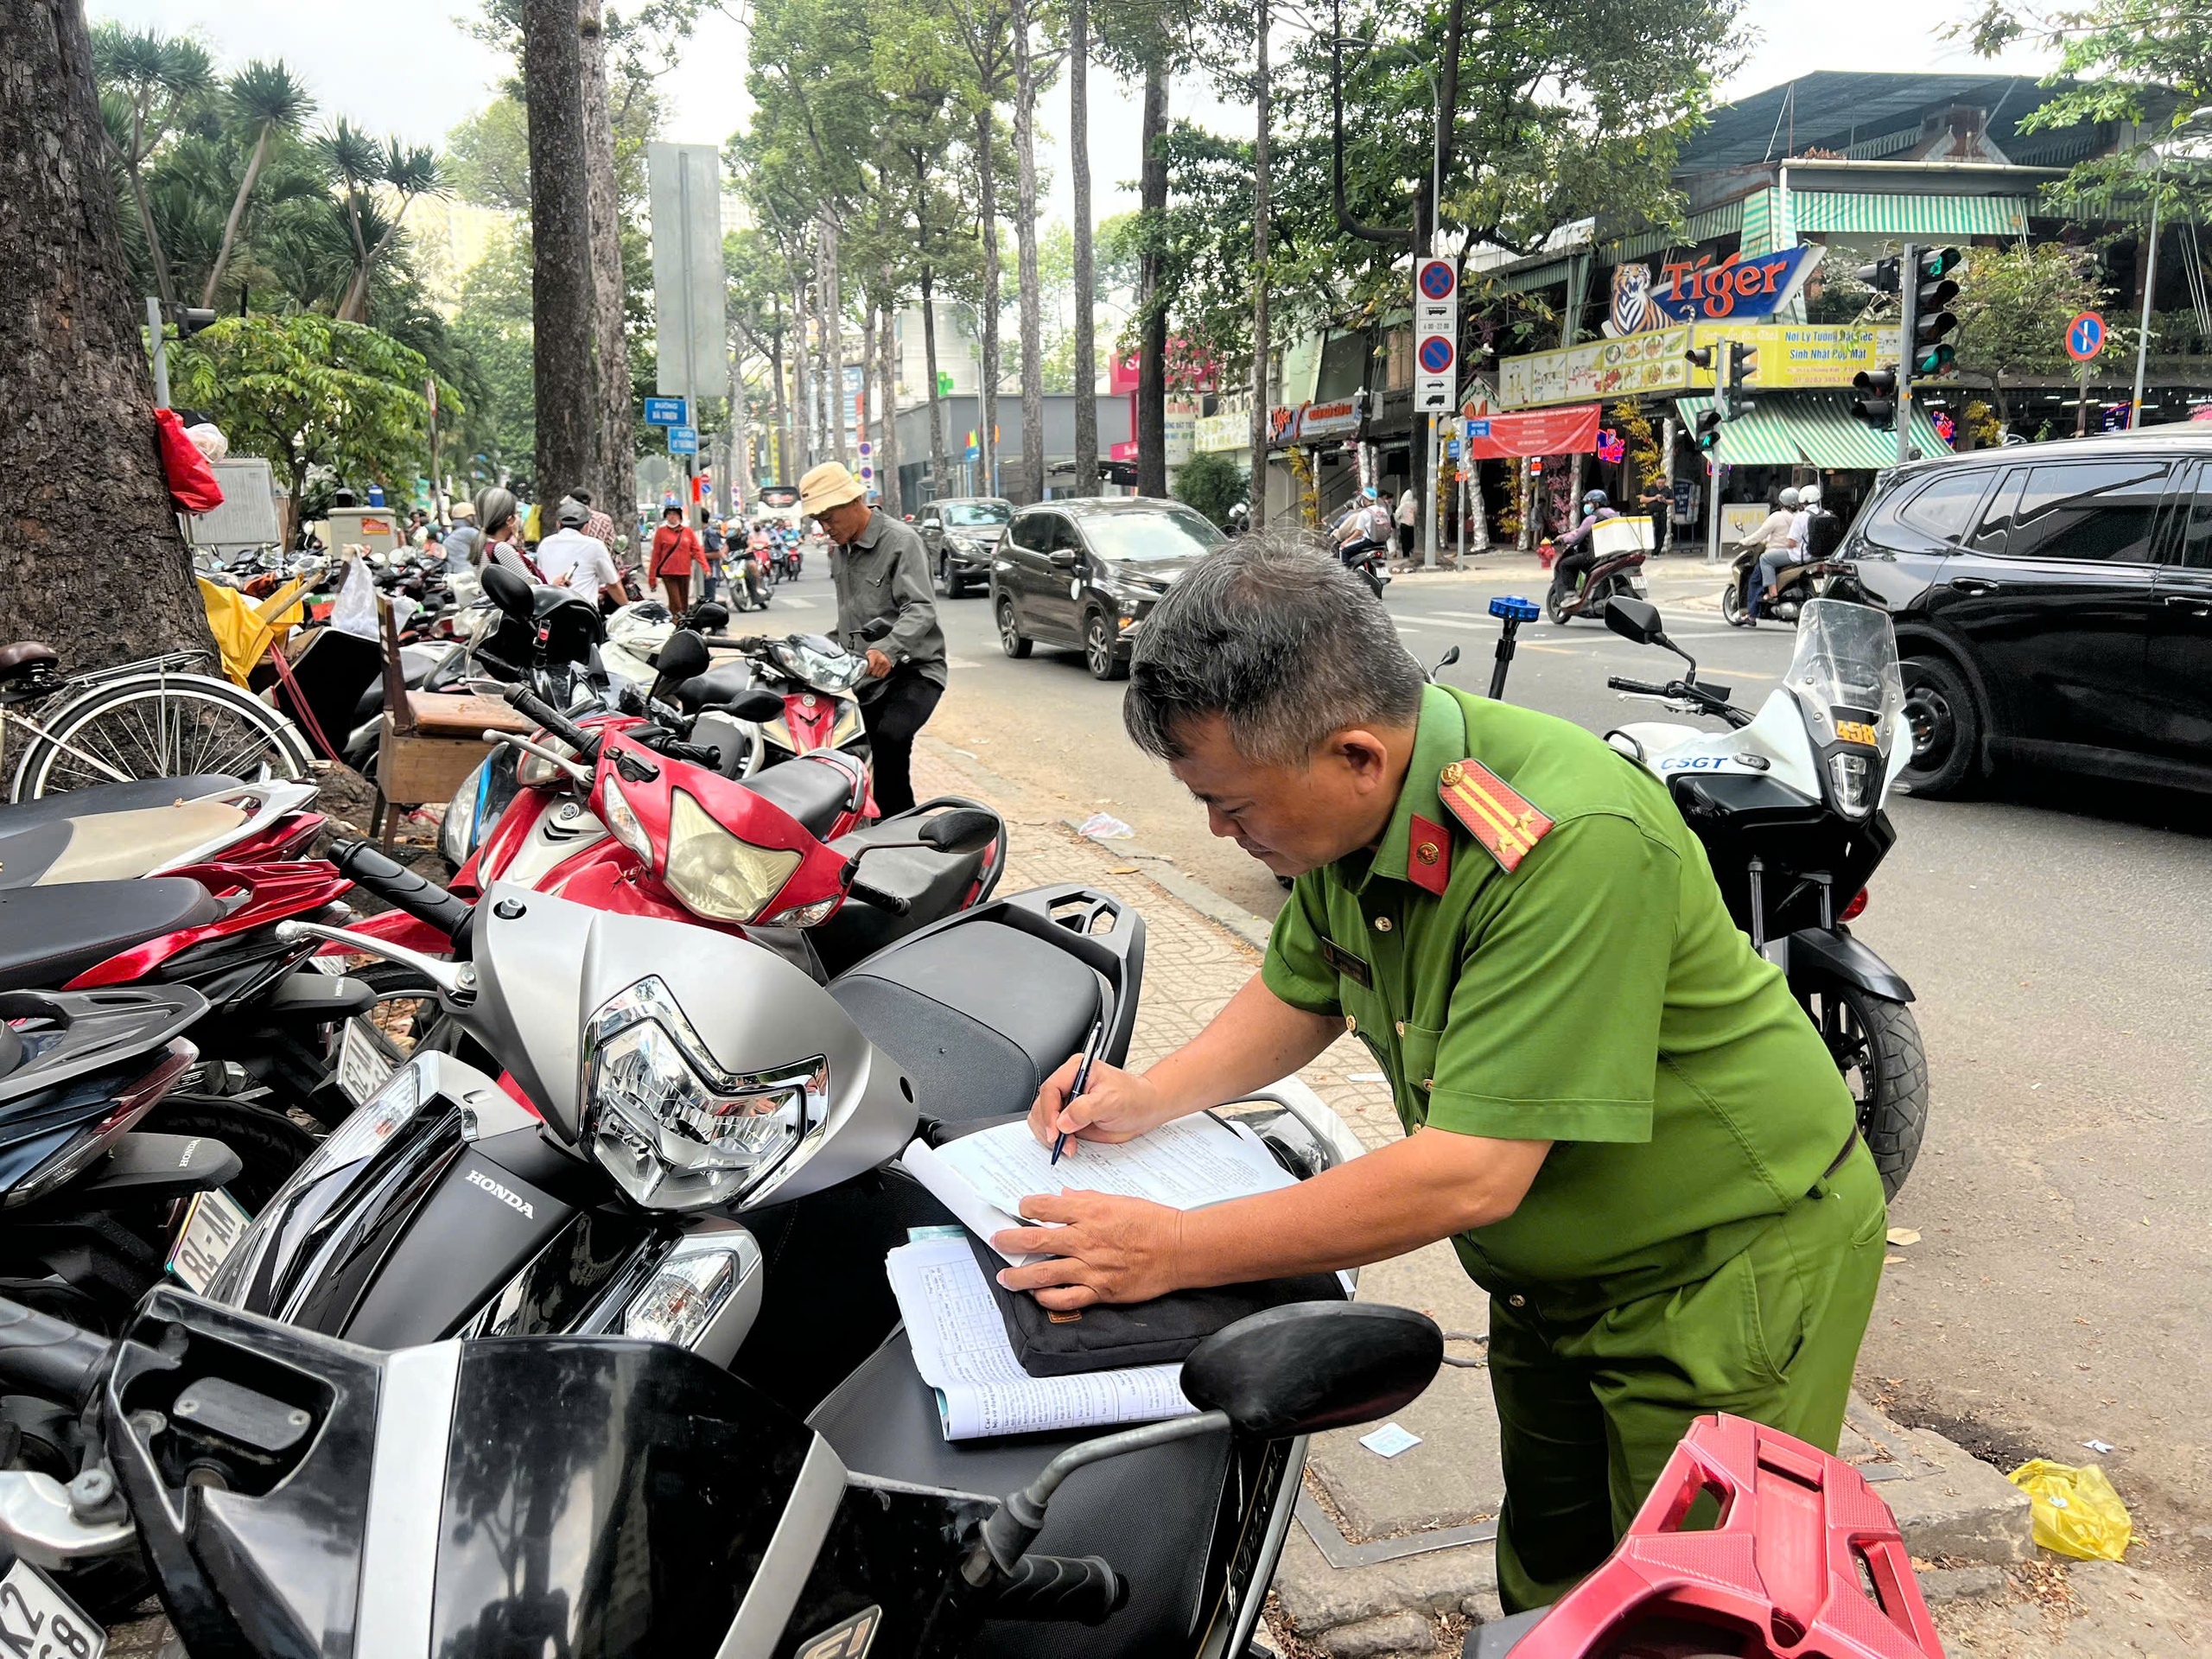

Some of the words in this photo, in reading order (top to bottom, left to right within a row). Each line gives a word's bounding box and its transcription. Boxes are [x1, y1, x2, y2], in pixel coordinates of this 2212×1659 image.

[1662, 251, 1788, 318] Tiger
[1789, 349, 1808, 359] Sinh
[1836, 720, 1876, 746] 458
[1661, 757, 1728, 770] CSGT
[334, 977, 345, 997] HONDA
[178, 1139, 201, 1167] HONDA
[465, 1169, 534, 1220] HONDA
